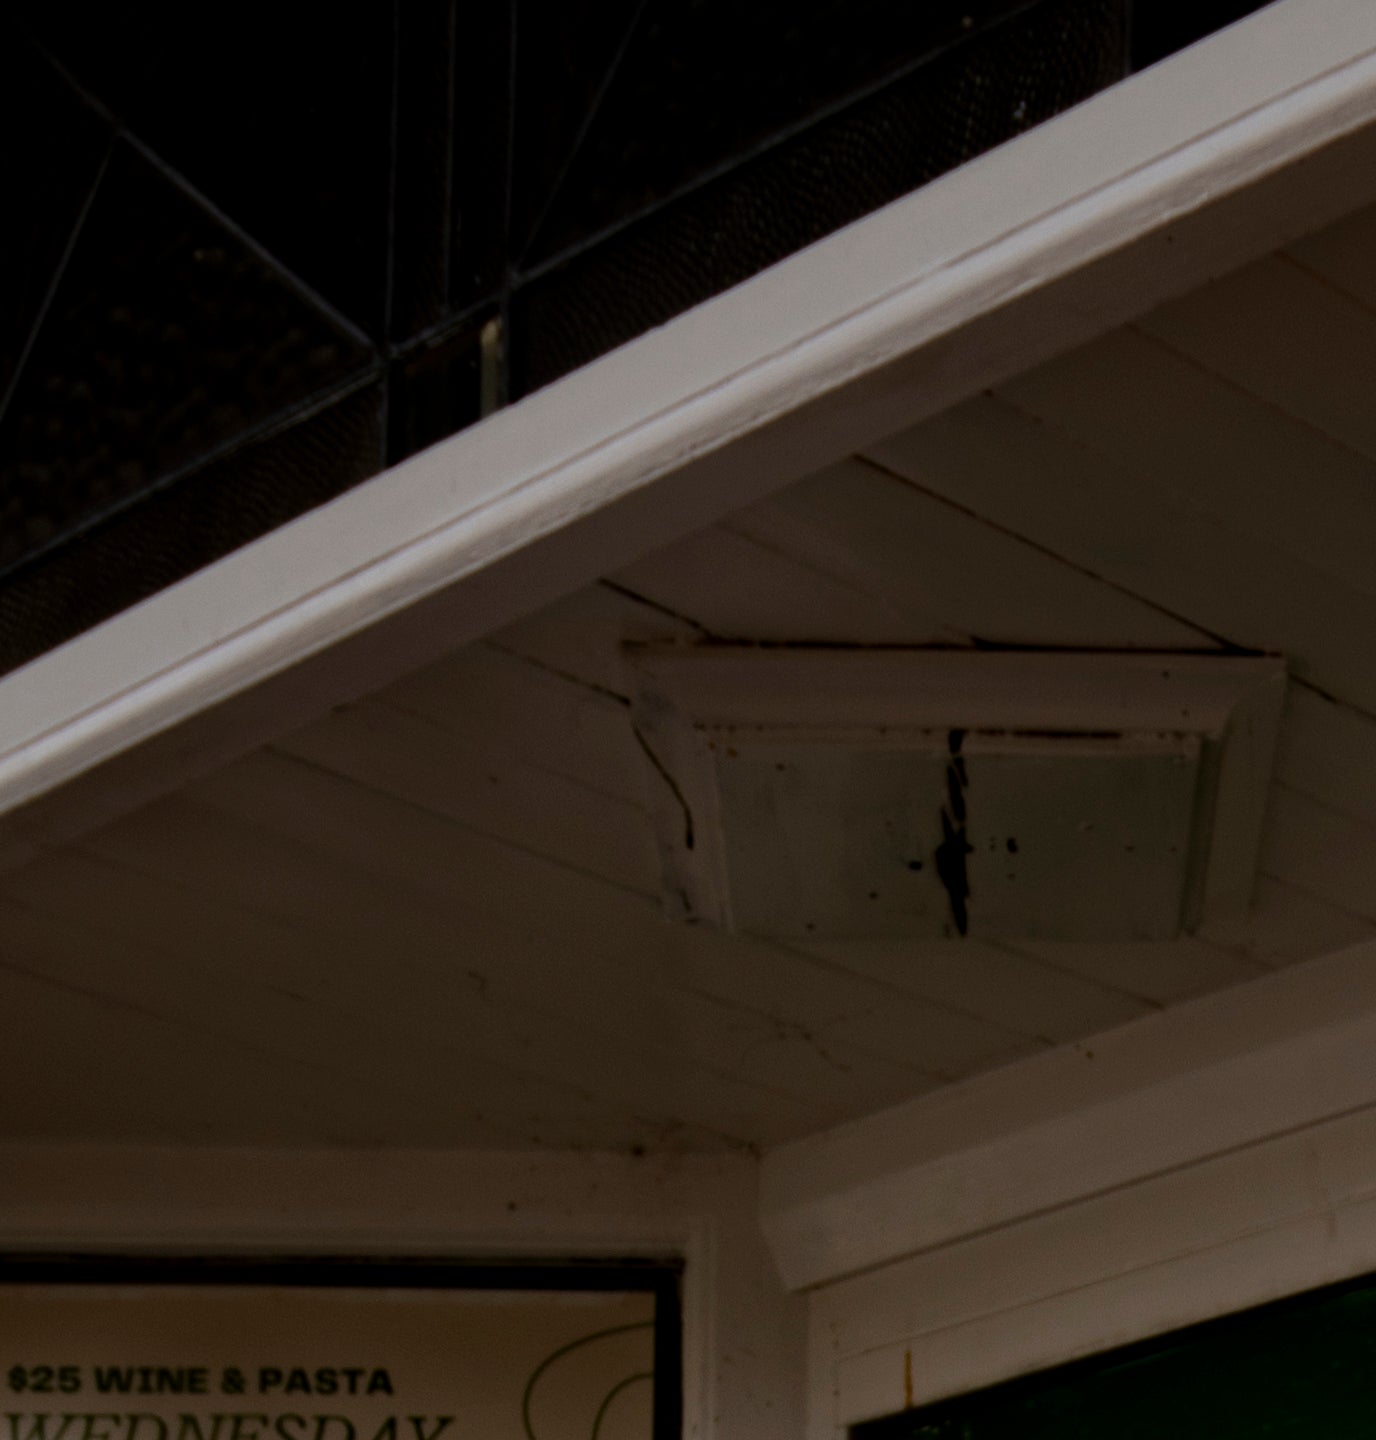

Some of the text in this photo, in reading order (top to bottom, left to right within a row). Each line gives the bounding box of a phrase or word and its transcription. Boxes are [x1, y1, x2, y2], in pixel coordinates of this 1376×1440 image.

[7, 1365, 394, 1396] $25 WINE & PASTA
